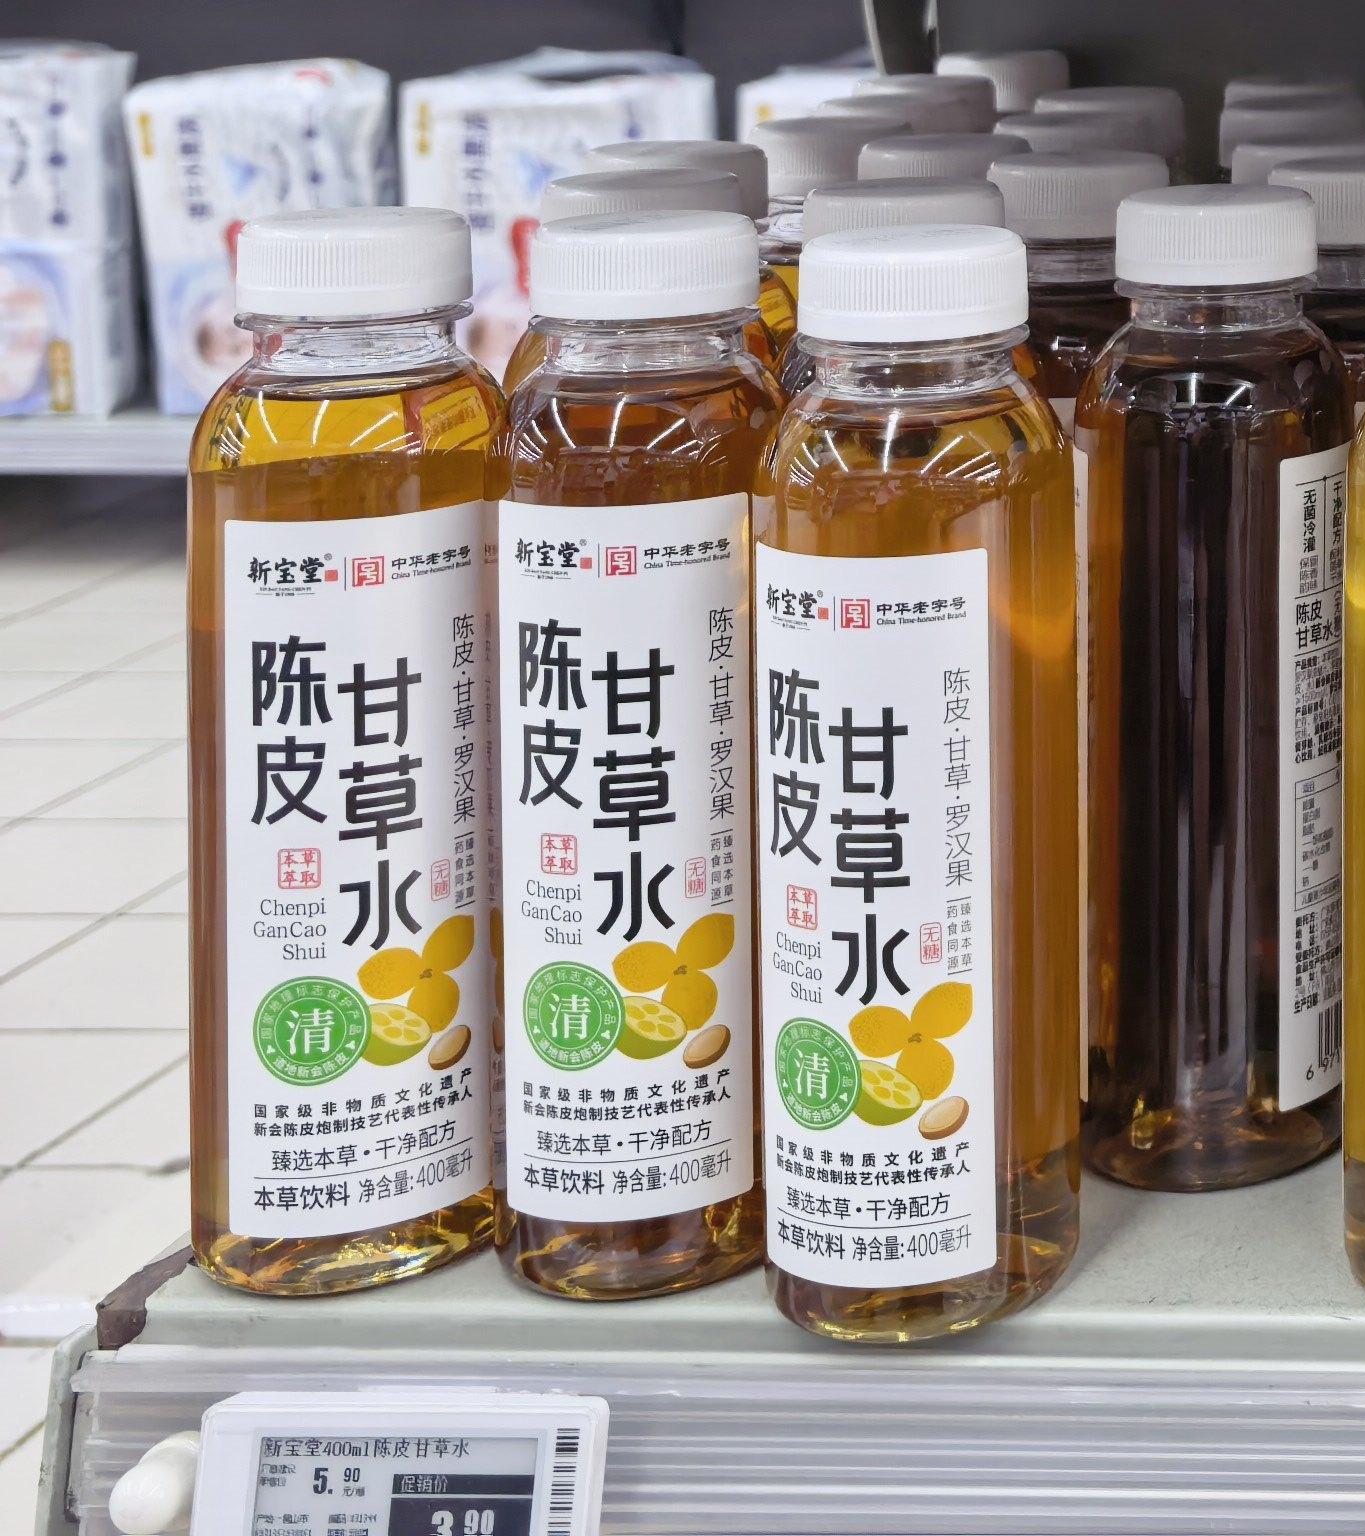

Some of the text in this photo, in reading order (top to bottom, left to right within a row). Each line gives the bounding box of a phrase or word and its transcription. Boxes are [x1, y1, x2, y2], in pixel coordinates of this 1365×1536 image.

[644, 539, 731, 560] 中华老字号
[247, 556, 325, 586] 新宝堂
[767, 583, 817, 619] 新宝堂
[526, 880, 581, 902] Chenpi
[260, 898, 326, 917] Chenpi
[283, 944, 326, 960] Shui
[287, 1008, 335, 1055] 清
[254, 1181, 350, 1211] 本草饮料
[777, 1219, 845, 1260] 本草饮料
[264, 1438, 470, 1459] 新宝堂400ml陈皮甘草水
